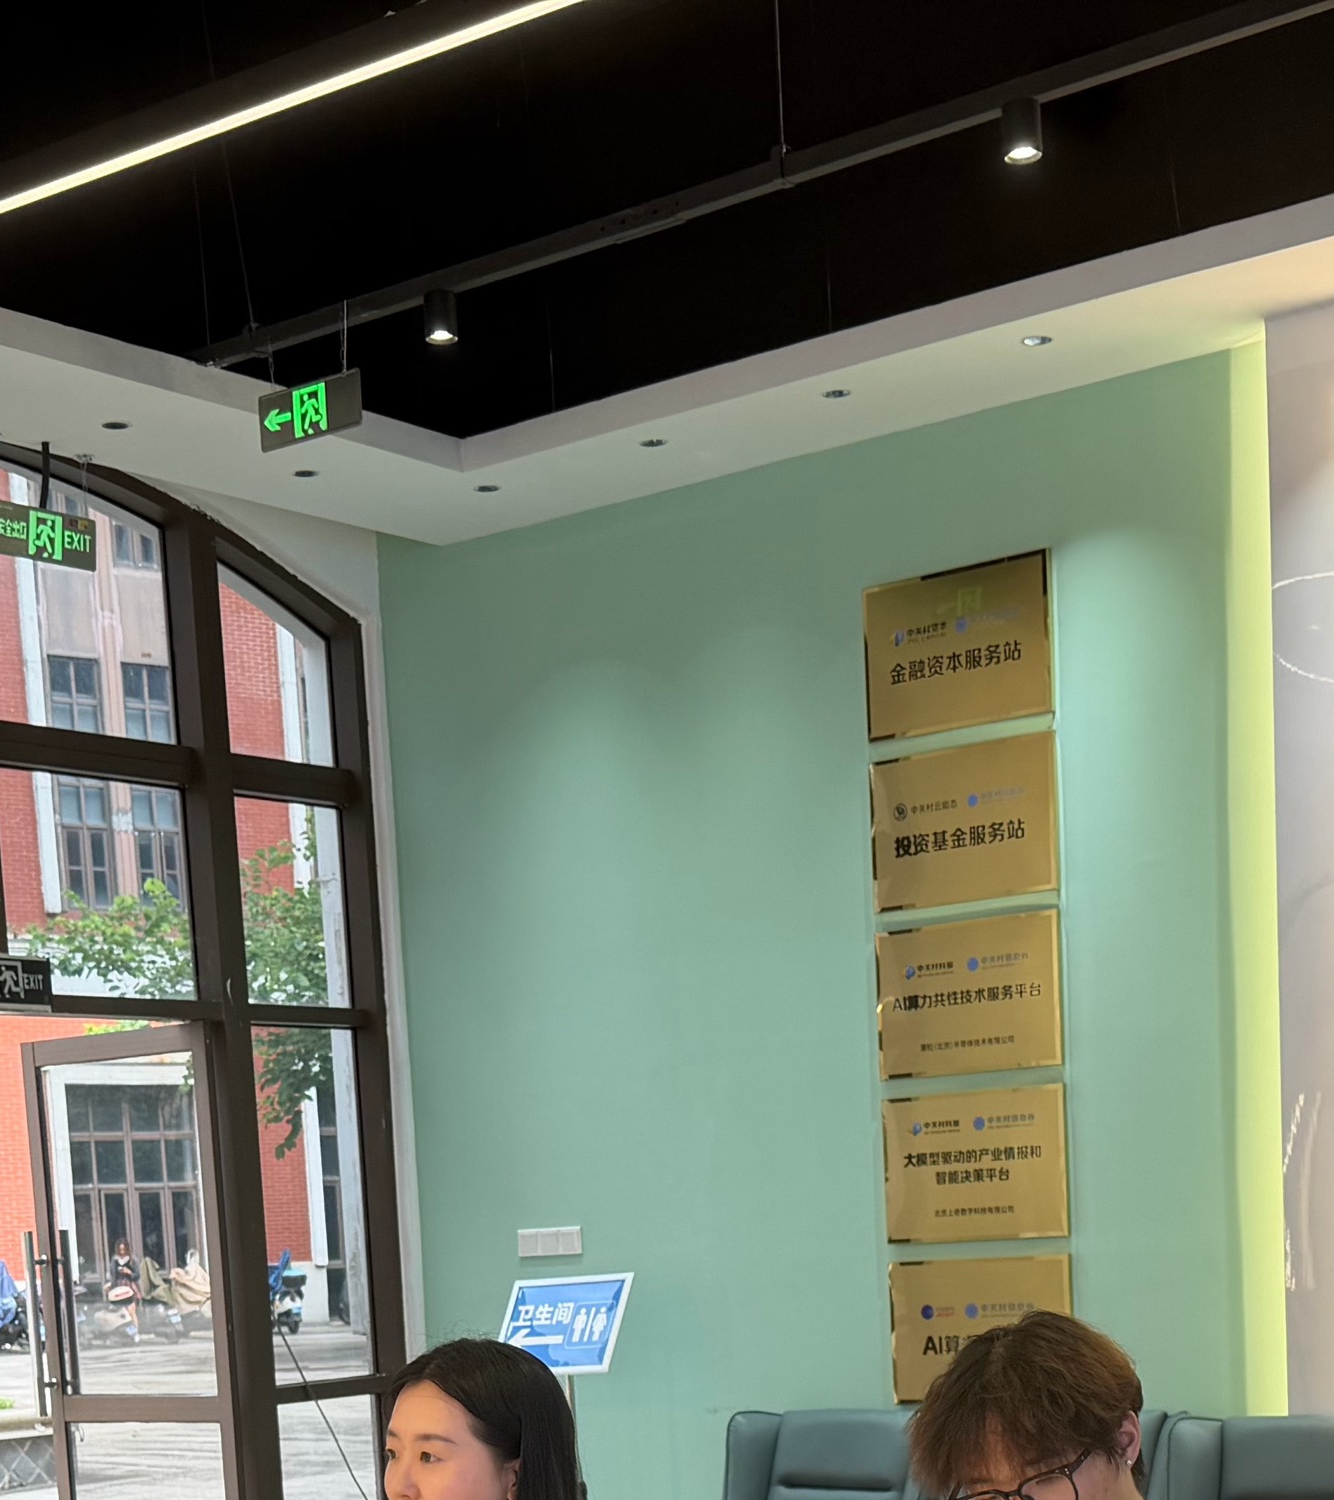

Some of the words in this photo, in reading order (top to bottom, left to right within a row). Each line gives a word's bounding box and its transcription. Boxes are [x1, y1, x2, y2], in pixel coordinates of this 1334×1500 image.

[64, 530, 92, 553] EXIT
[890, 640, 1022, 685] 金融资本服务站
[895, 818, 1025, 858] 投资基金服务站
[23, 973, 44, 991] EXIT
[892, 982, 1042, 1012] AI算力共性技术服务平台
[903, 1145, 1042, 1169] 大模型驱动的产业情报和
[935, 1166, 1010, 1186] 智能决策平台
[513, 1301, 575, 1327] 卫生间
[922, 1334, 975, 1356] AI算
